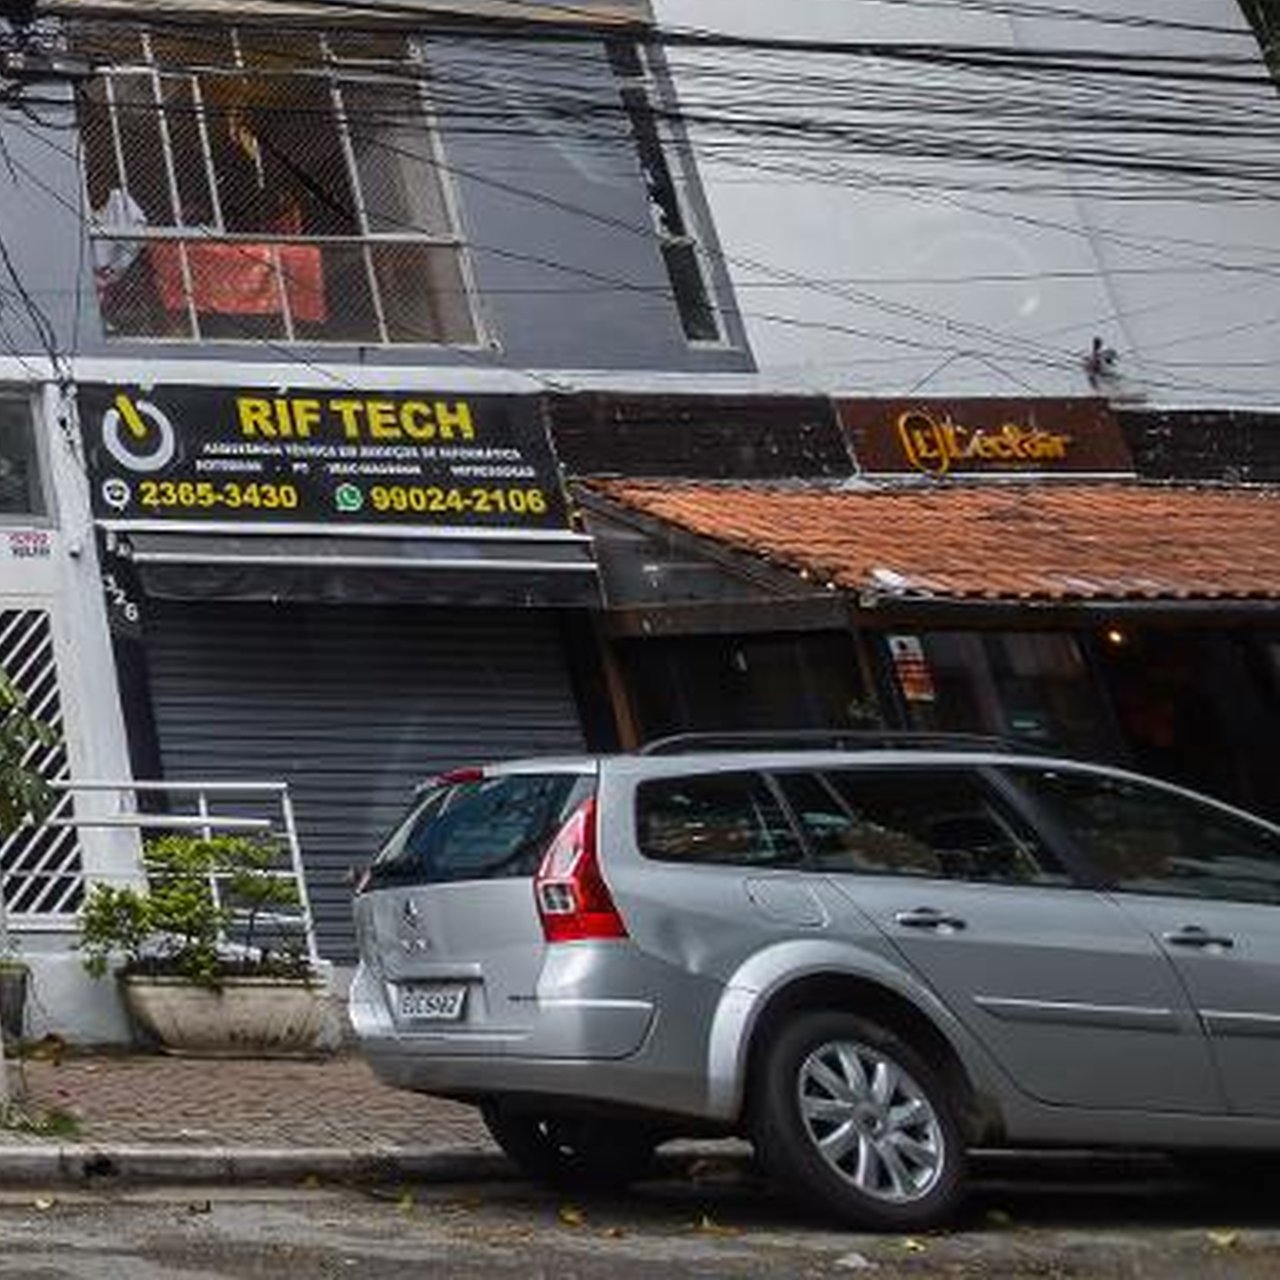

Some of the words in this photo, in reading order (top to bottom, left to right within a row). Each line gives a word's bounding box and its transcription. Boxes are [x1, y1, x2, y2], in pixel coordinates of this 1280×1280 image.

[238, 396, 322, 438] RIF
[329, 399, 475, 440] TECH
[139, 480, 299, 509] 2365-3430
[370, 485, 547, 514] 99024-2106
